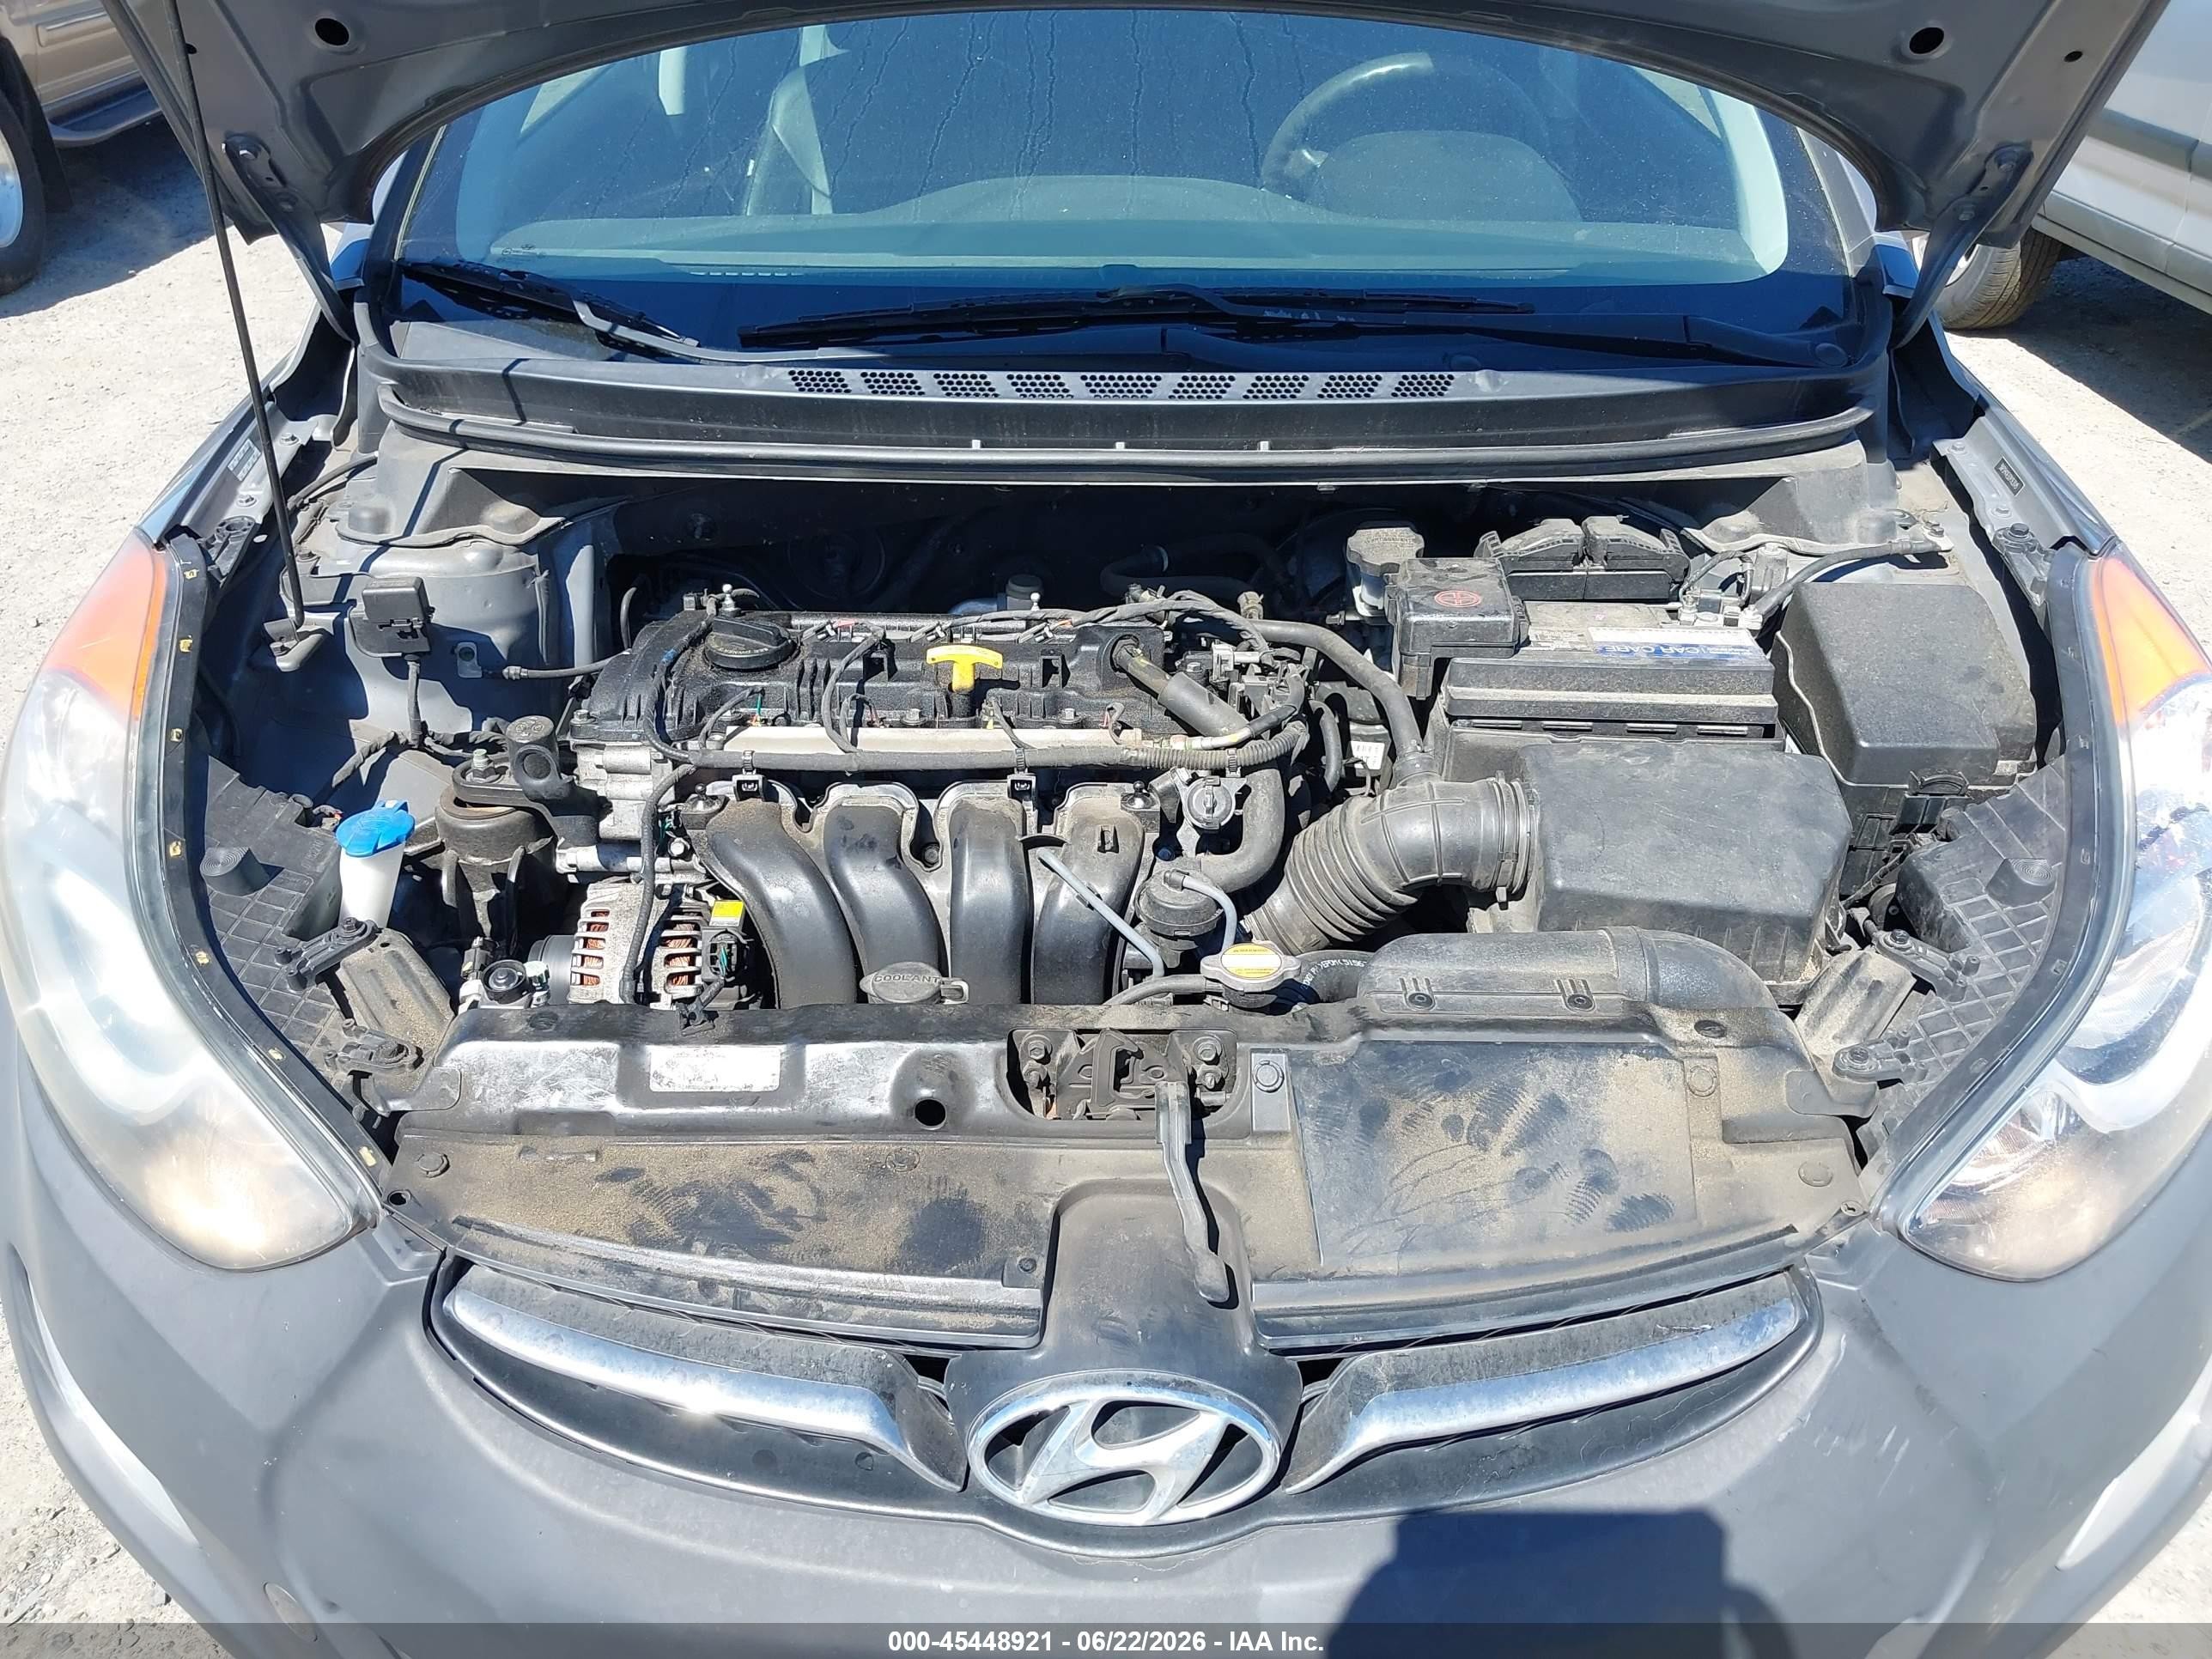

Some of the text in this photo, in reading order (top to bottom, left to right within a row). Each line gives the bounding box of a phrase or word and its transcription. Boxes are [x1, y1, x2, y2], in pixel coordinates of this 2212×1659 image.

[1605, 645, 1655, 653] CARE
[1660, 646, 1700, 654] CAR
[874, 974, 941, 983] COOLANT
